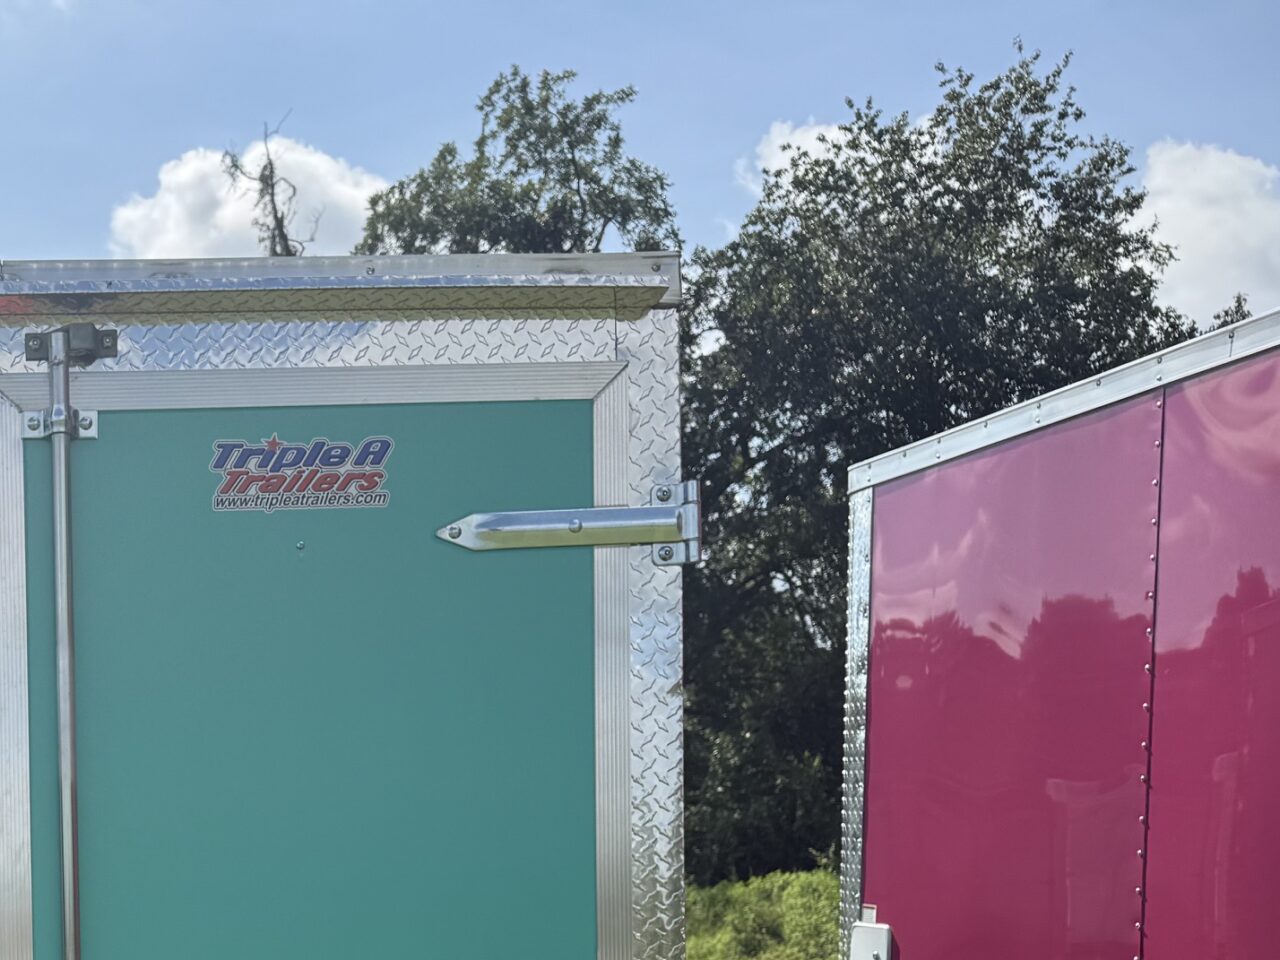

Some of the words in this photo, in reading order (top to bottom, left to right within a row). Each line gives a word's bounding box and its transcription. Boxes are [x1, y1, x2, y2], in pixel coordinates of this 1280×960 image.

[211, 440, 352, 473] Triple
[351, 438, 392, 467] A
[218, 468, 385, 495] Trailers
[215, 492, 388, 511] www.tripleatrailers.com
